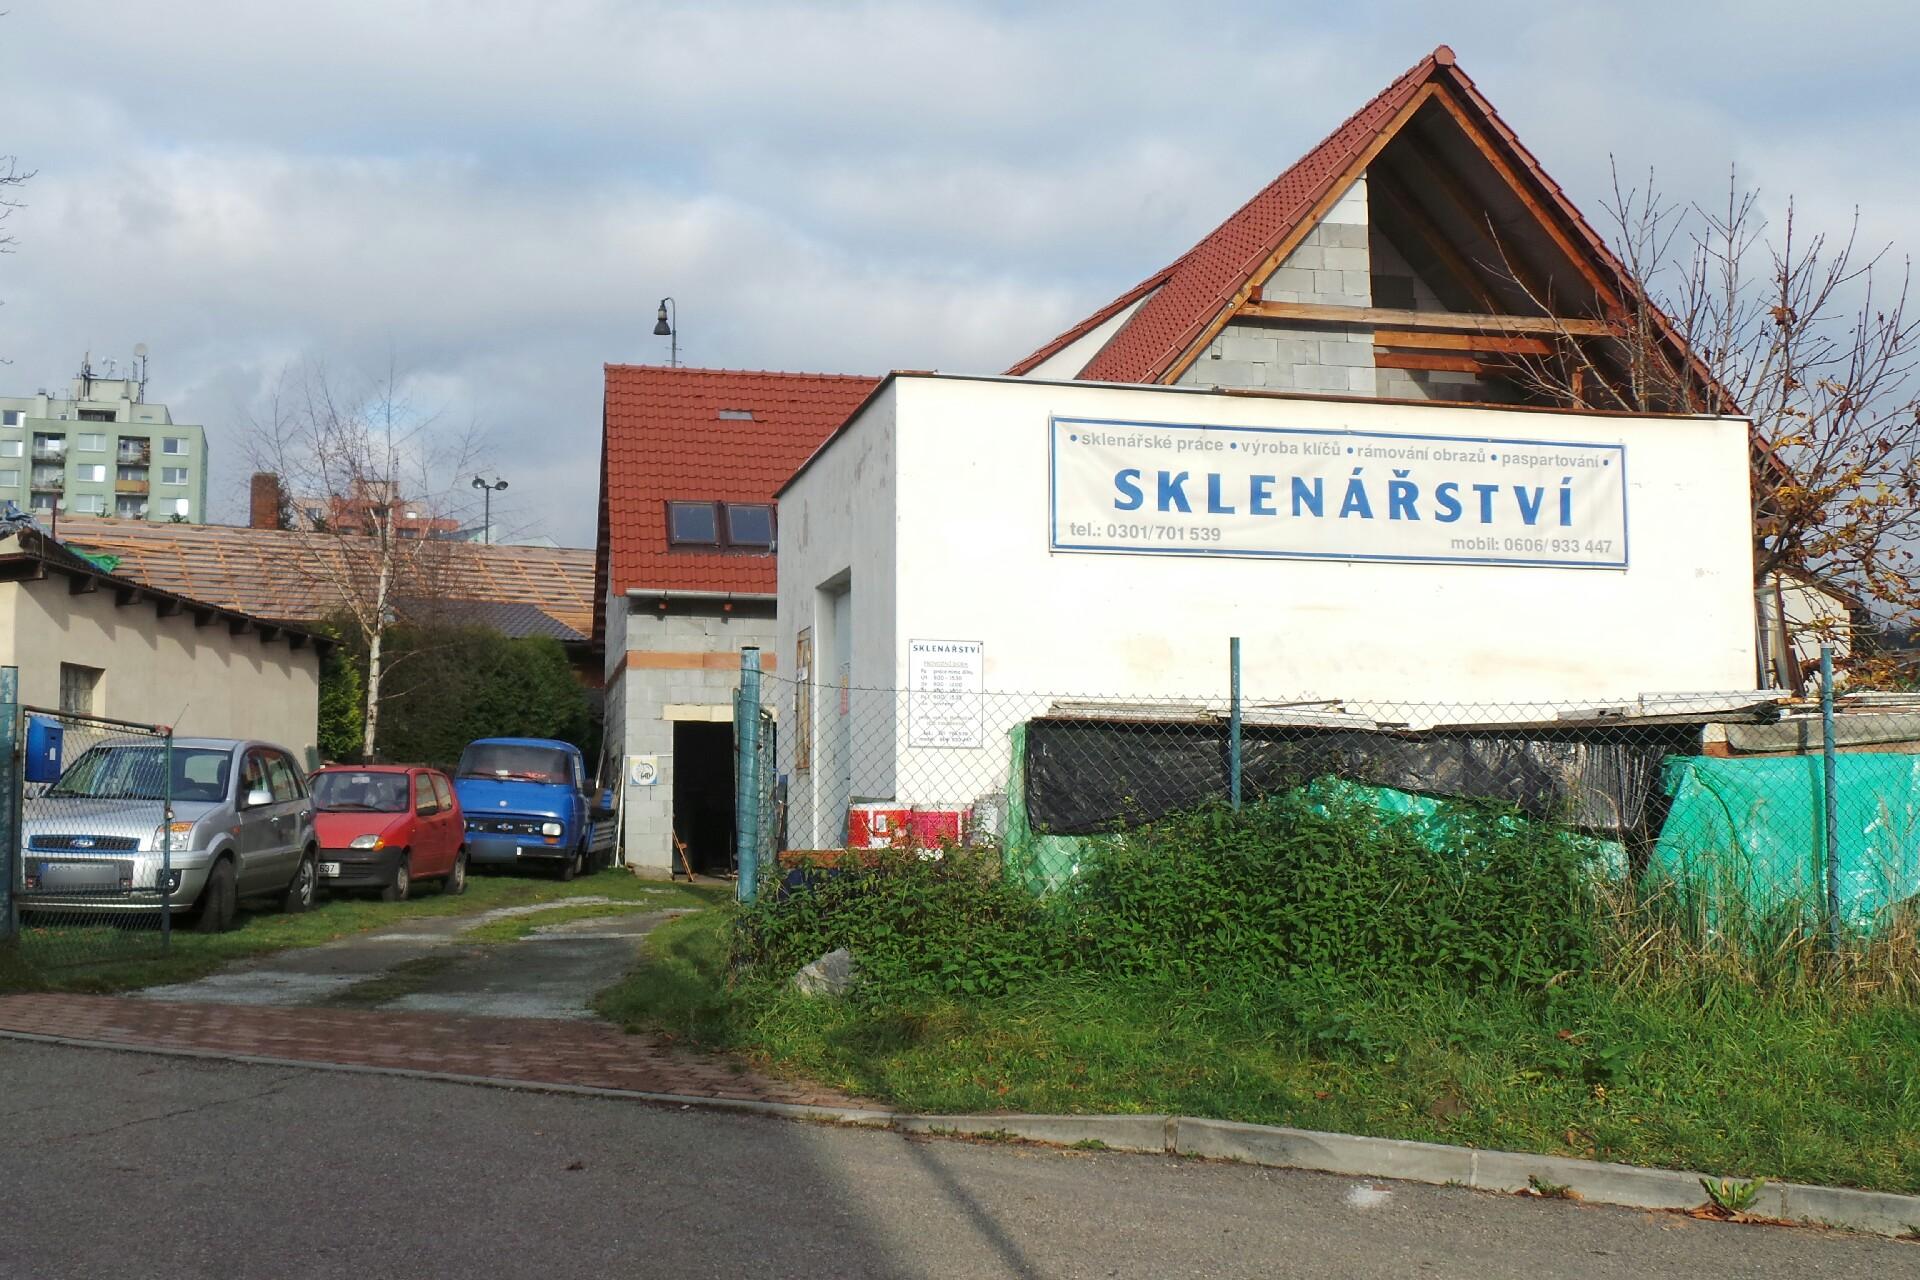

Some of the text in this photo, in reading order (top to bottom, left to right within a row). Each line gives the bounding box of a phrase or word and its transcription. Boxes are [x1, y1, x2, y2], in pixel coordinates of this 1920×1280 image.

[1081, 432, 1600, 468] sklenářské práce výroba klíčů rámování obrazů paspartování
[1114, 466, 1573, 527] SKLENÁŘSTVÍ
[1069, 522, 1101, 537] tel.:
[1189, 527, 1221, 541] 539
[1451, 536, 1499, 551] mobil:
[1584, 540, 1612, 553] 447
